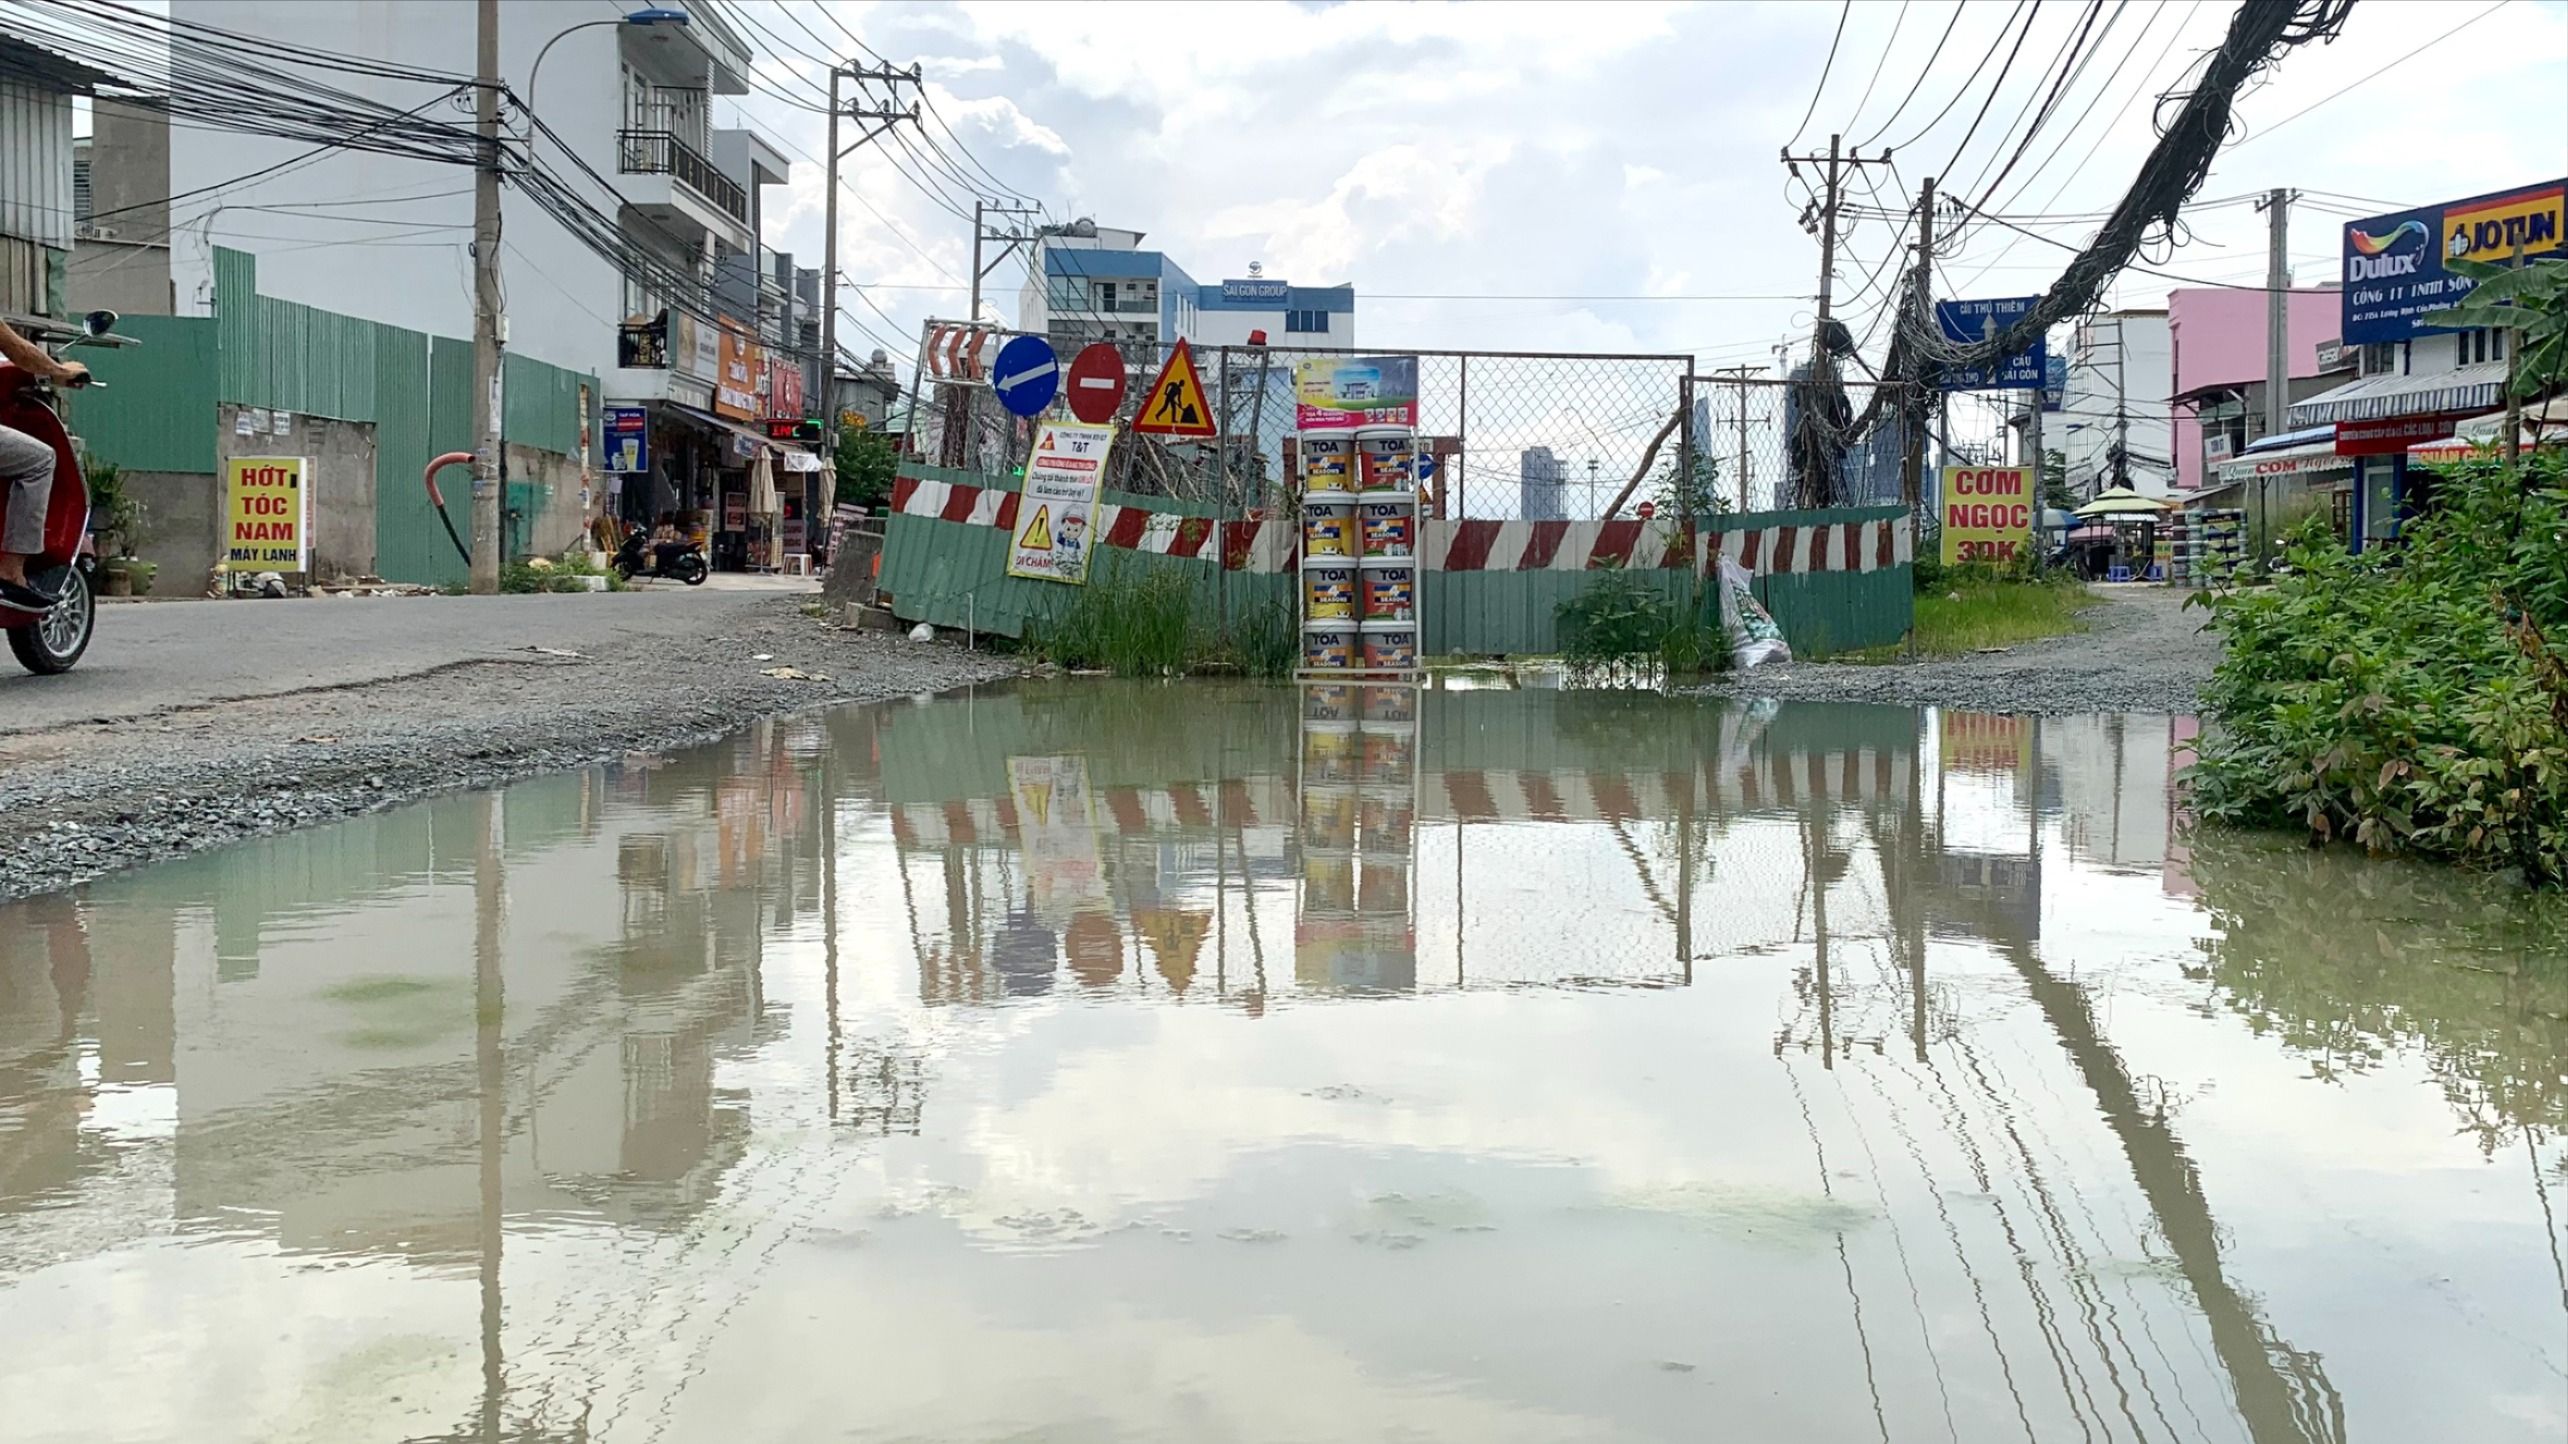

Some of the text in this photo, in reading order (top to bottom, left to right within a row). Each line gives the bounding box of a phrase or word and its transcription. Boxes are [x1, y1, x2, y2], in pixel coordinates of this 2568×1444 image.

[2471, 210, 2556, 253] JOTUN
[2350, 252, 2417, 282] Dulux
[1258, 284, 1287, 297] GROUP
[1072, 441, 1090, 453] T&T
[1312, 441, 1339, 453] TOA
[1380, 440, 1407, 451] TOA
[241, 464, 288, 487] HỚT
[1955, 468, 2022, 496] CƠM
[241, 492, 288, 516] TÓC
[1308, 505, 1333, 517] TOA
[1369, 505, 1398, 516] TOA
[1948, 503, 2029, 534] NGỌC
[235, 521, 293, 541] NAM
[230, 544, 297, 565] MÁY LẠNH
[1319, 570, 1347, 581] TOA
[1380, 570, 1407, 581] TOA
[1312, 634, 1340, 646] TOA
[1383, 634, 1409, 645] TOA
